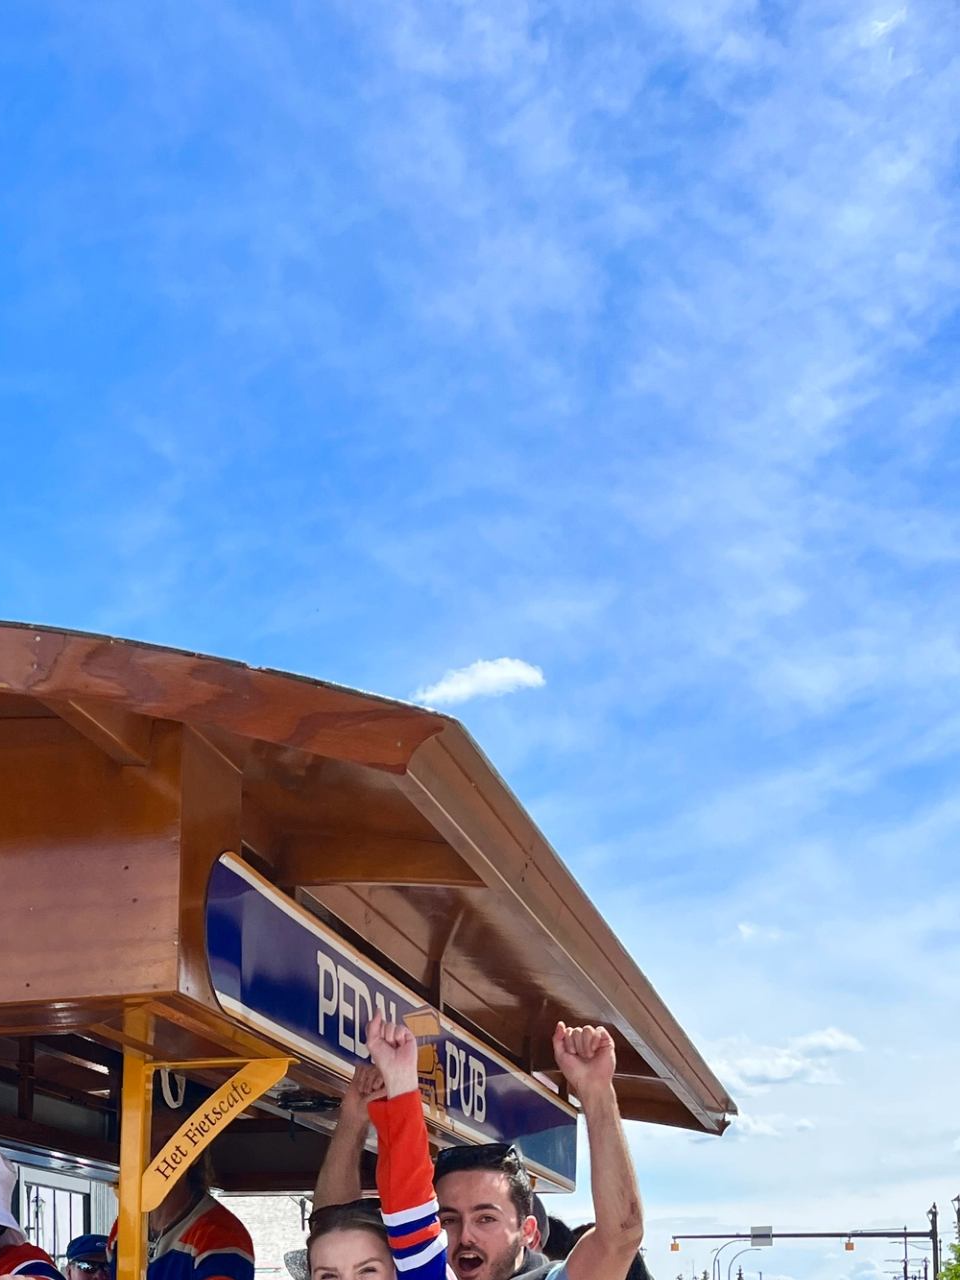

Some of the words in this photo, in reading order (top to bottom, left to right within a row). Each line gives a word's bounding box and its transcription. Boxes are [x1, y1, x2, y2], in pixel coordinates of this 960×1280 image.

[445, 1040, 487, 1123] PUB
[154, 1145, 189, 1182] Het
[183, 1080, 253, 1148] Fietscafe
